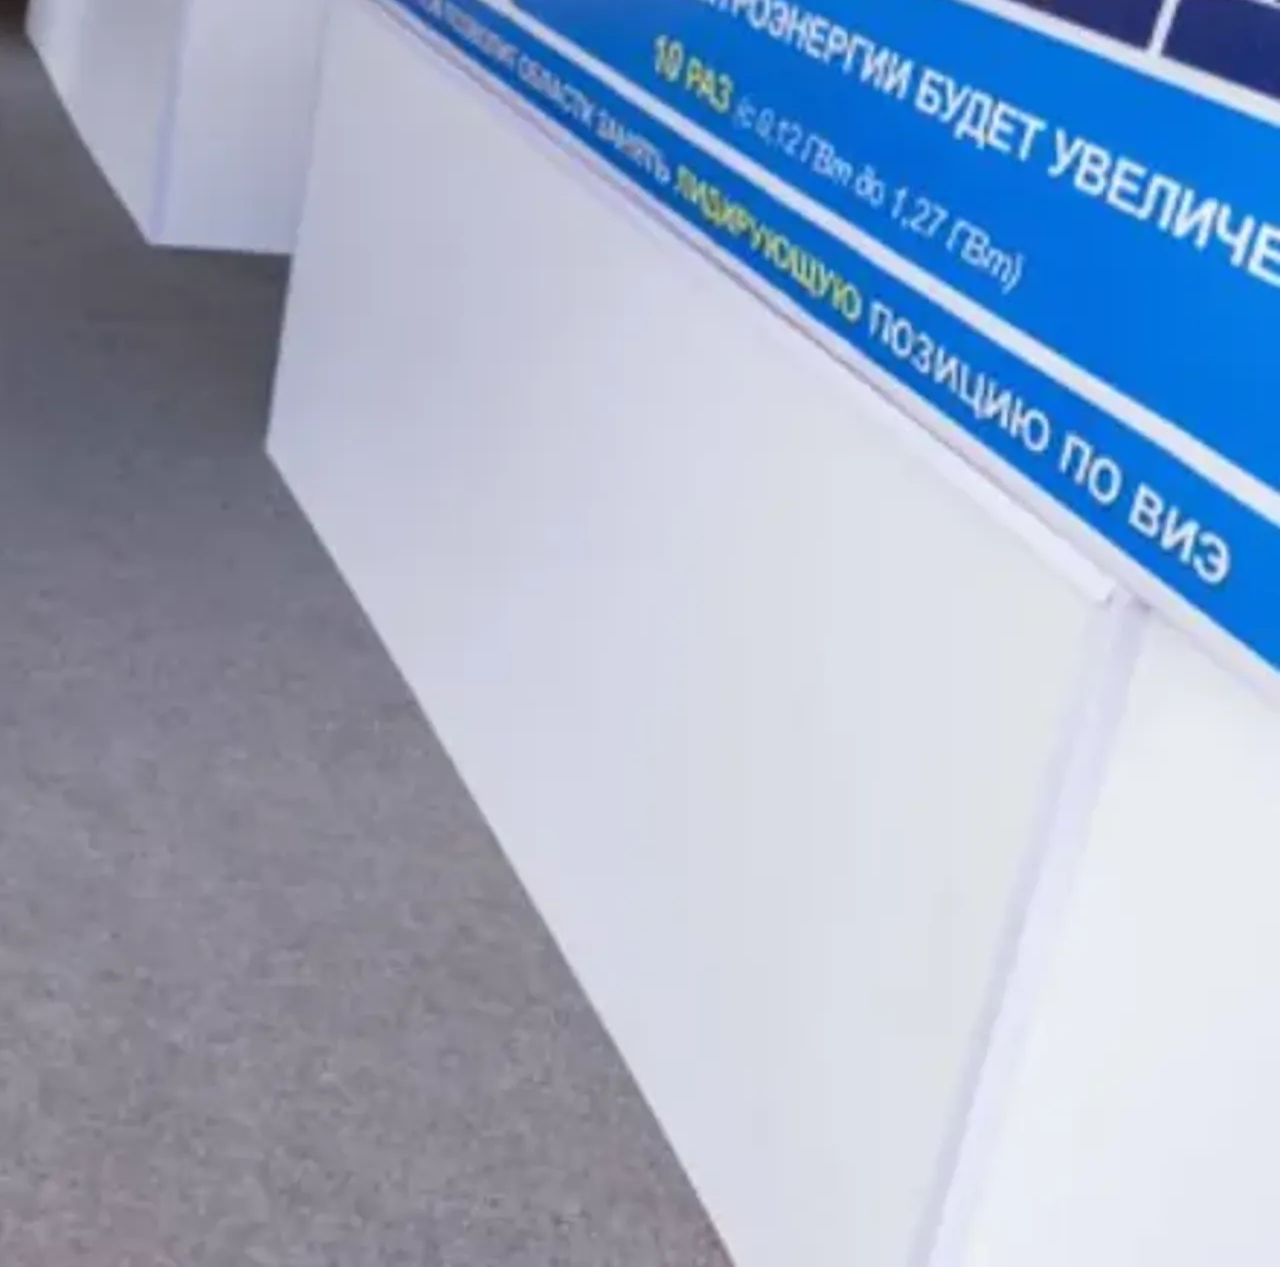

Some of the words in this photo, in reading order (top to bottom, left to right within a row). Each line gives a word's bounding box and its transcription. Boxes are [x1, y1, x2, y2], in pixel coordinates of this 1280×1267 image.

[654, 34, 685, 82] 10
[685, 56, 735, 114] РАЗ
[854, 162, 886, 209] до
[890, 185, 950, 239] 1,27
[914, 68, 1047, 162] БУДЕТ
[1047, 128, 1280, 289] УВЕЛИЧЕ
[673, 164, 864, 324] ЛИДИРУЮЩУЮ
[868, 299, 1053, 453] ПОЗИЦИЮ
[1057, 432, 1123, 507] ПО
[1128, 484, 1233, 586] ВИЭ
